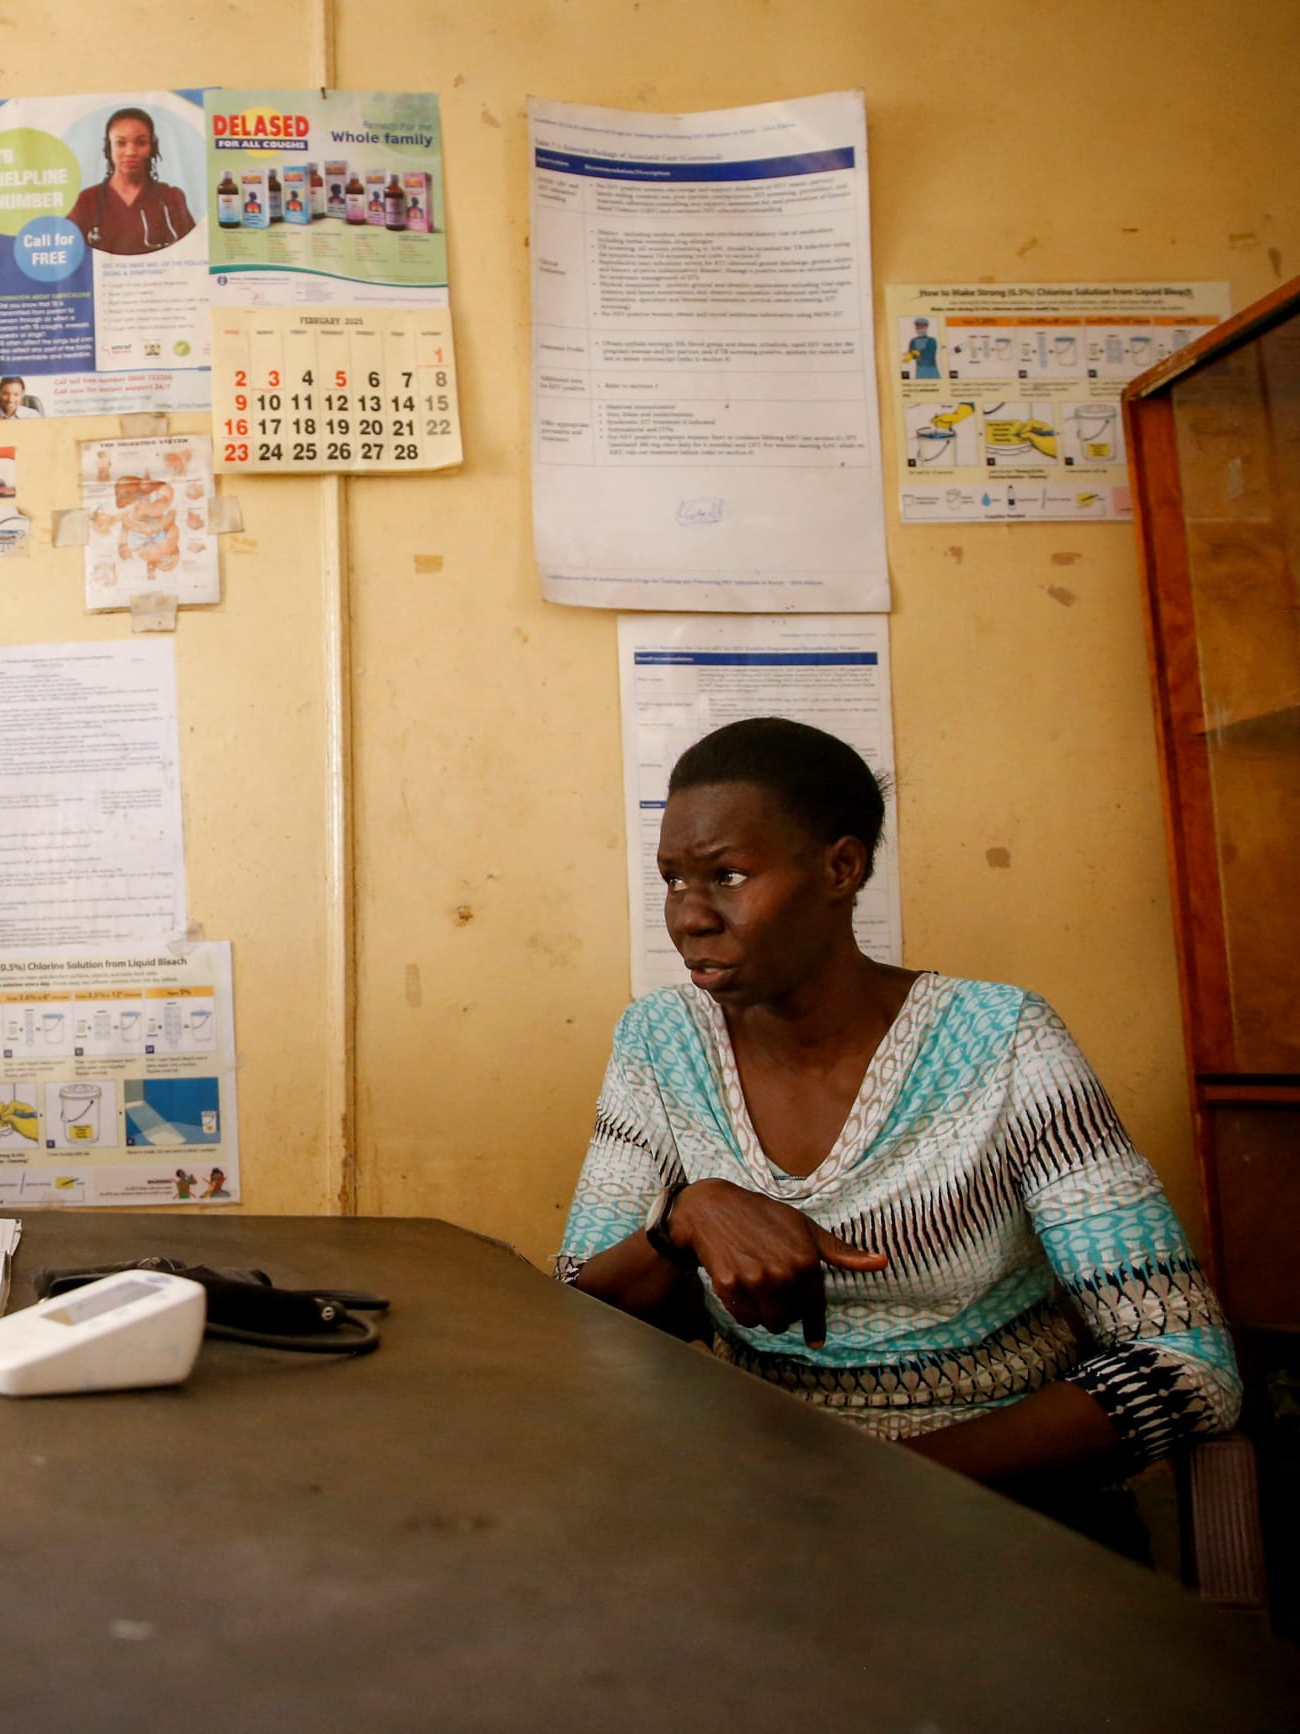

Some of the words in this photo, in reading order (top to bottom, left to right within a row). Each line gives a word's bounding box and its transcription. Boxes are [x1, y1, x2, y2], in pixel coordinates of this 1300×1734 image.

[212, 114, 310, 137] DELASED
[218, 140, 240, 149] FOR
[241, 140, 262, 149] ALL
[263, 140, 306, 149] COUGHS
[331, 131, 380, 144] Whole
[384, 131, 433, 148] family
[23, 234, 51, 248] Call
[54, 233, 75, 246] for
[31, 251, 67, 265] FREE
[919, 289, 939, 297] How
[977, 288, 1006, 298] Strong
[1037, 288, 1073, 296] Chlorine
[1075, 288, 1111, 296] Solution
[1112, 288, 1133, 296] from
[1135, 288, 1163, 298] Liquid
[1164, 288, 1192, 297] Bleach
[300, 317, 340, 325] FEBRUARY
[434, 348, 443, 363] 1
[235, 370, 247, 387] 2
[268, 370, 280, 387] 3
[302, 370, 314, 386] 4
[335, 371, 347, 387] 5
[368, 371, 380, 388] 6
[402, 372, 413, 388] 7
[435, 371, 447, 387] 8
[235, 395, 247, 411] 9
[257, 395, 281, 411] 10
[292, 395, 313, 411] 11
[325, 395, 349, 412] 12
[358, 395, 382, 412] 13
[391, 395, 415, 412] 14
[425, 395, 449, 412] 15
[224, 419, 249, 436] 16
[258, 418, 282, 435] 17
[292, 418, 316, 435] 18
[326, 419, 350, 435] 19
[359, 419, 383, 436] 20
[393, 419, 415, 436] 21
[426, 419, 451, 436] 22
[224, 443, 249, 462] 23
[258, 443, 283, 461] 24
[293, 443, 317, 460] 25
[327, 443, 351, 460] 26
[361, 443, 384, 460] 27
[394, 444, 418, 460] 28
[27, 961, 65, 971] Chlorine
[67, 960, 103, 970] Solution
[105, 960, 126, 969] from
[128, 958, 156, 969] Liquid
[158, 957, 187, 967] Bleach
